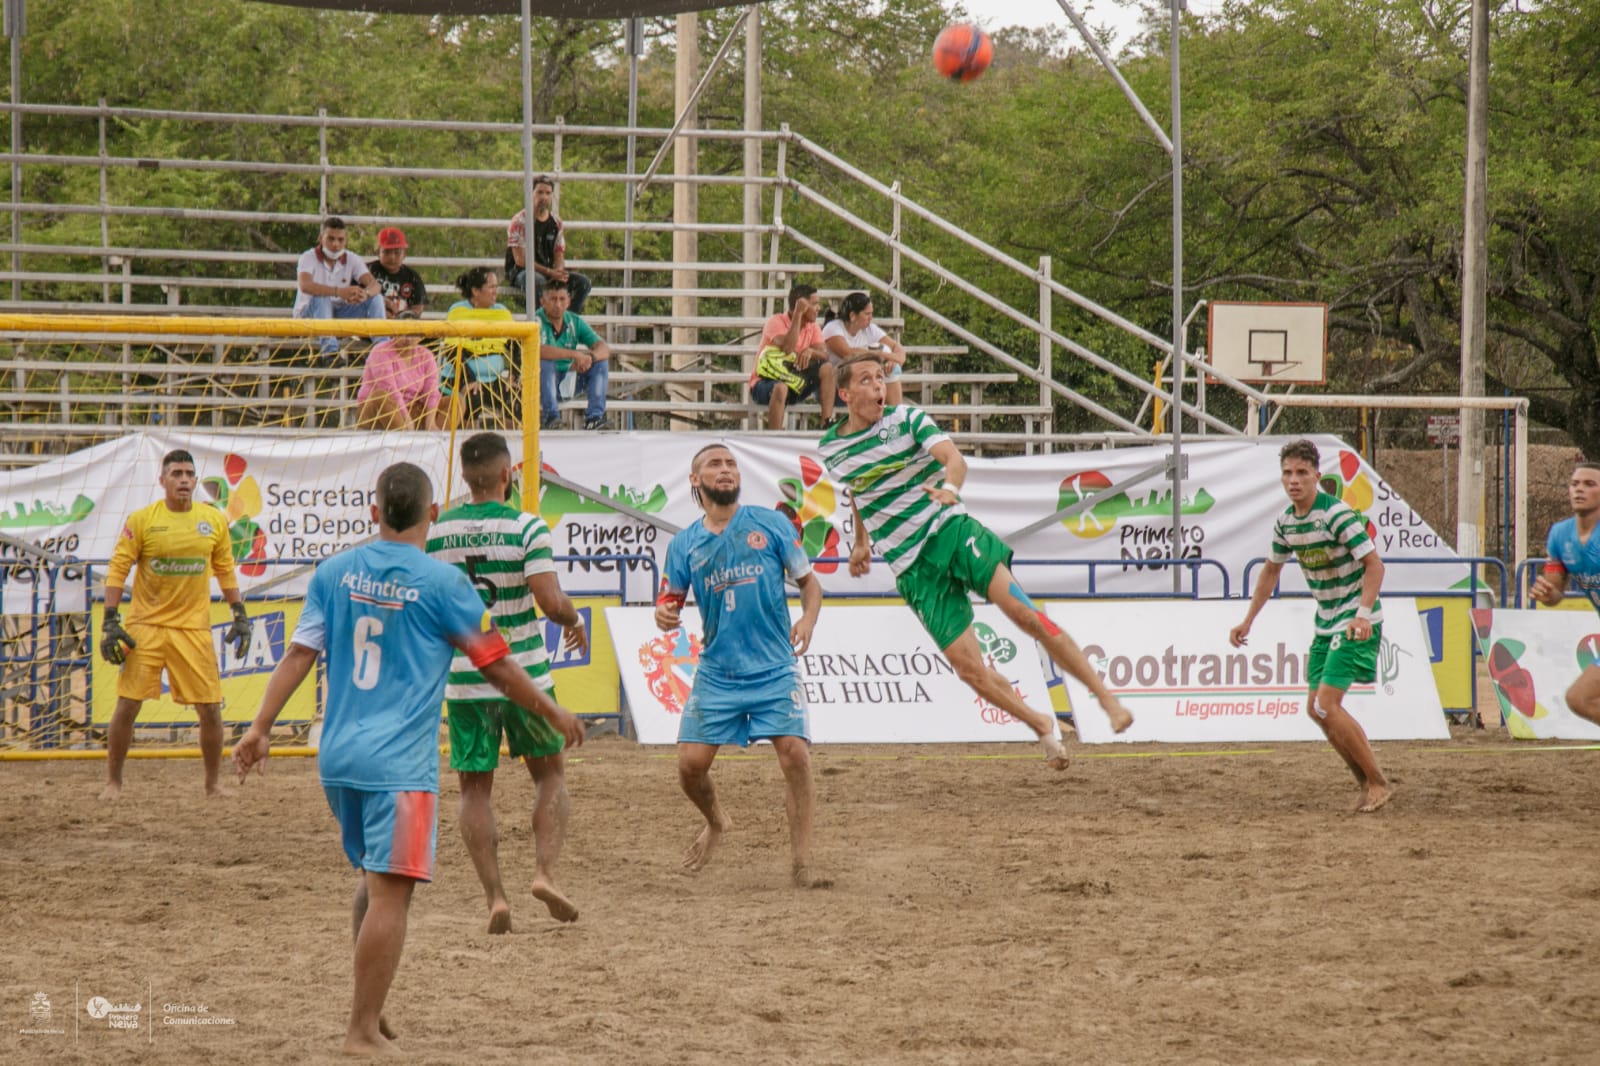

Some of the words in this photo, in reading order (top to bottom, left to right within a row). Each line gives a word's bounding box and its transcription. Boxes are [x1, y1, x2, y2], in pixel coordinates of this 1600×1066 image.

[269, 512, 297, 534] de
[1379, 506, 1402, 527] de
[566, 522, 657, 545] Primero
[1383, 534, 1394, 552] y
[340, 570, 420, 602] Atlántico
[465, 554, 497, 609] 5
[725, 590, 736, 612] 9
[352, 616, 384, 691] 6
[1329, 634, 1341, 650] 8
[1082, 643, 1310, 687] Cootransh
[840, 681, 933, 704] HUILA
[1175, 699, 1255, 720] Llegamos
[1257, 697, 1300, 720] Lejos
